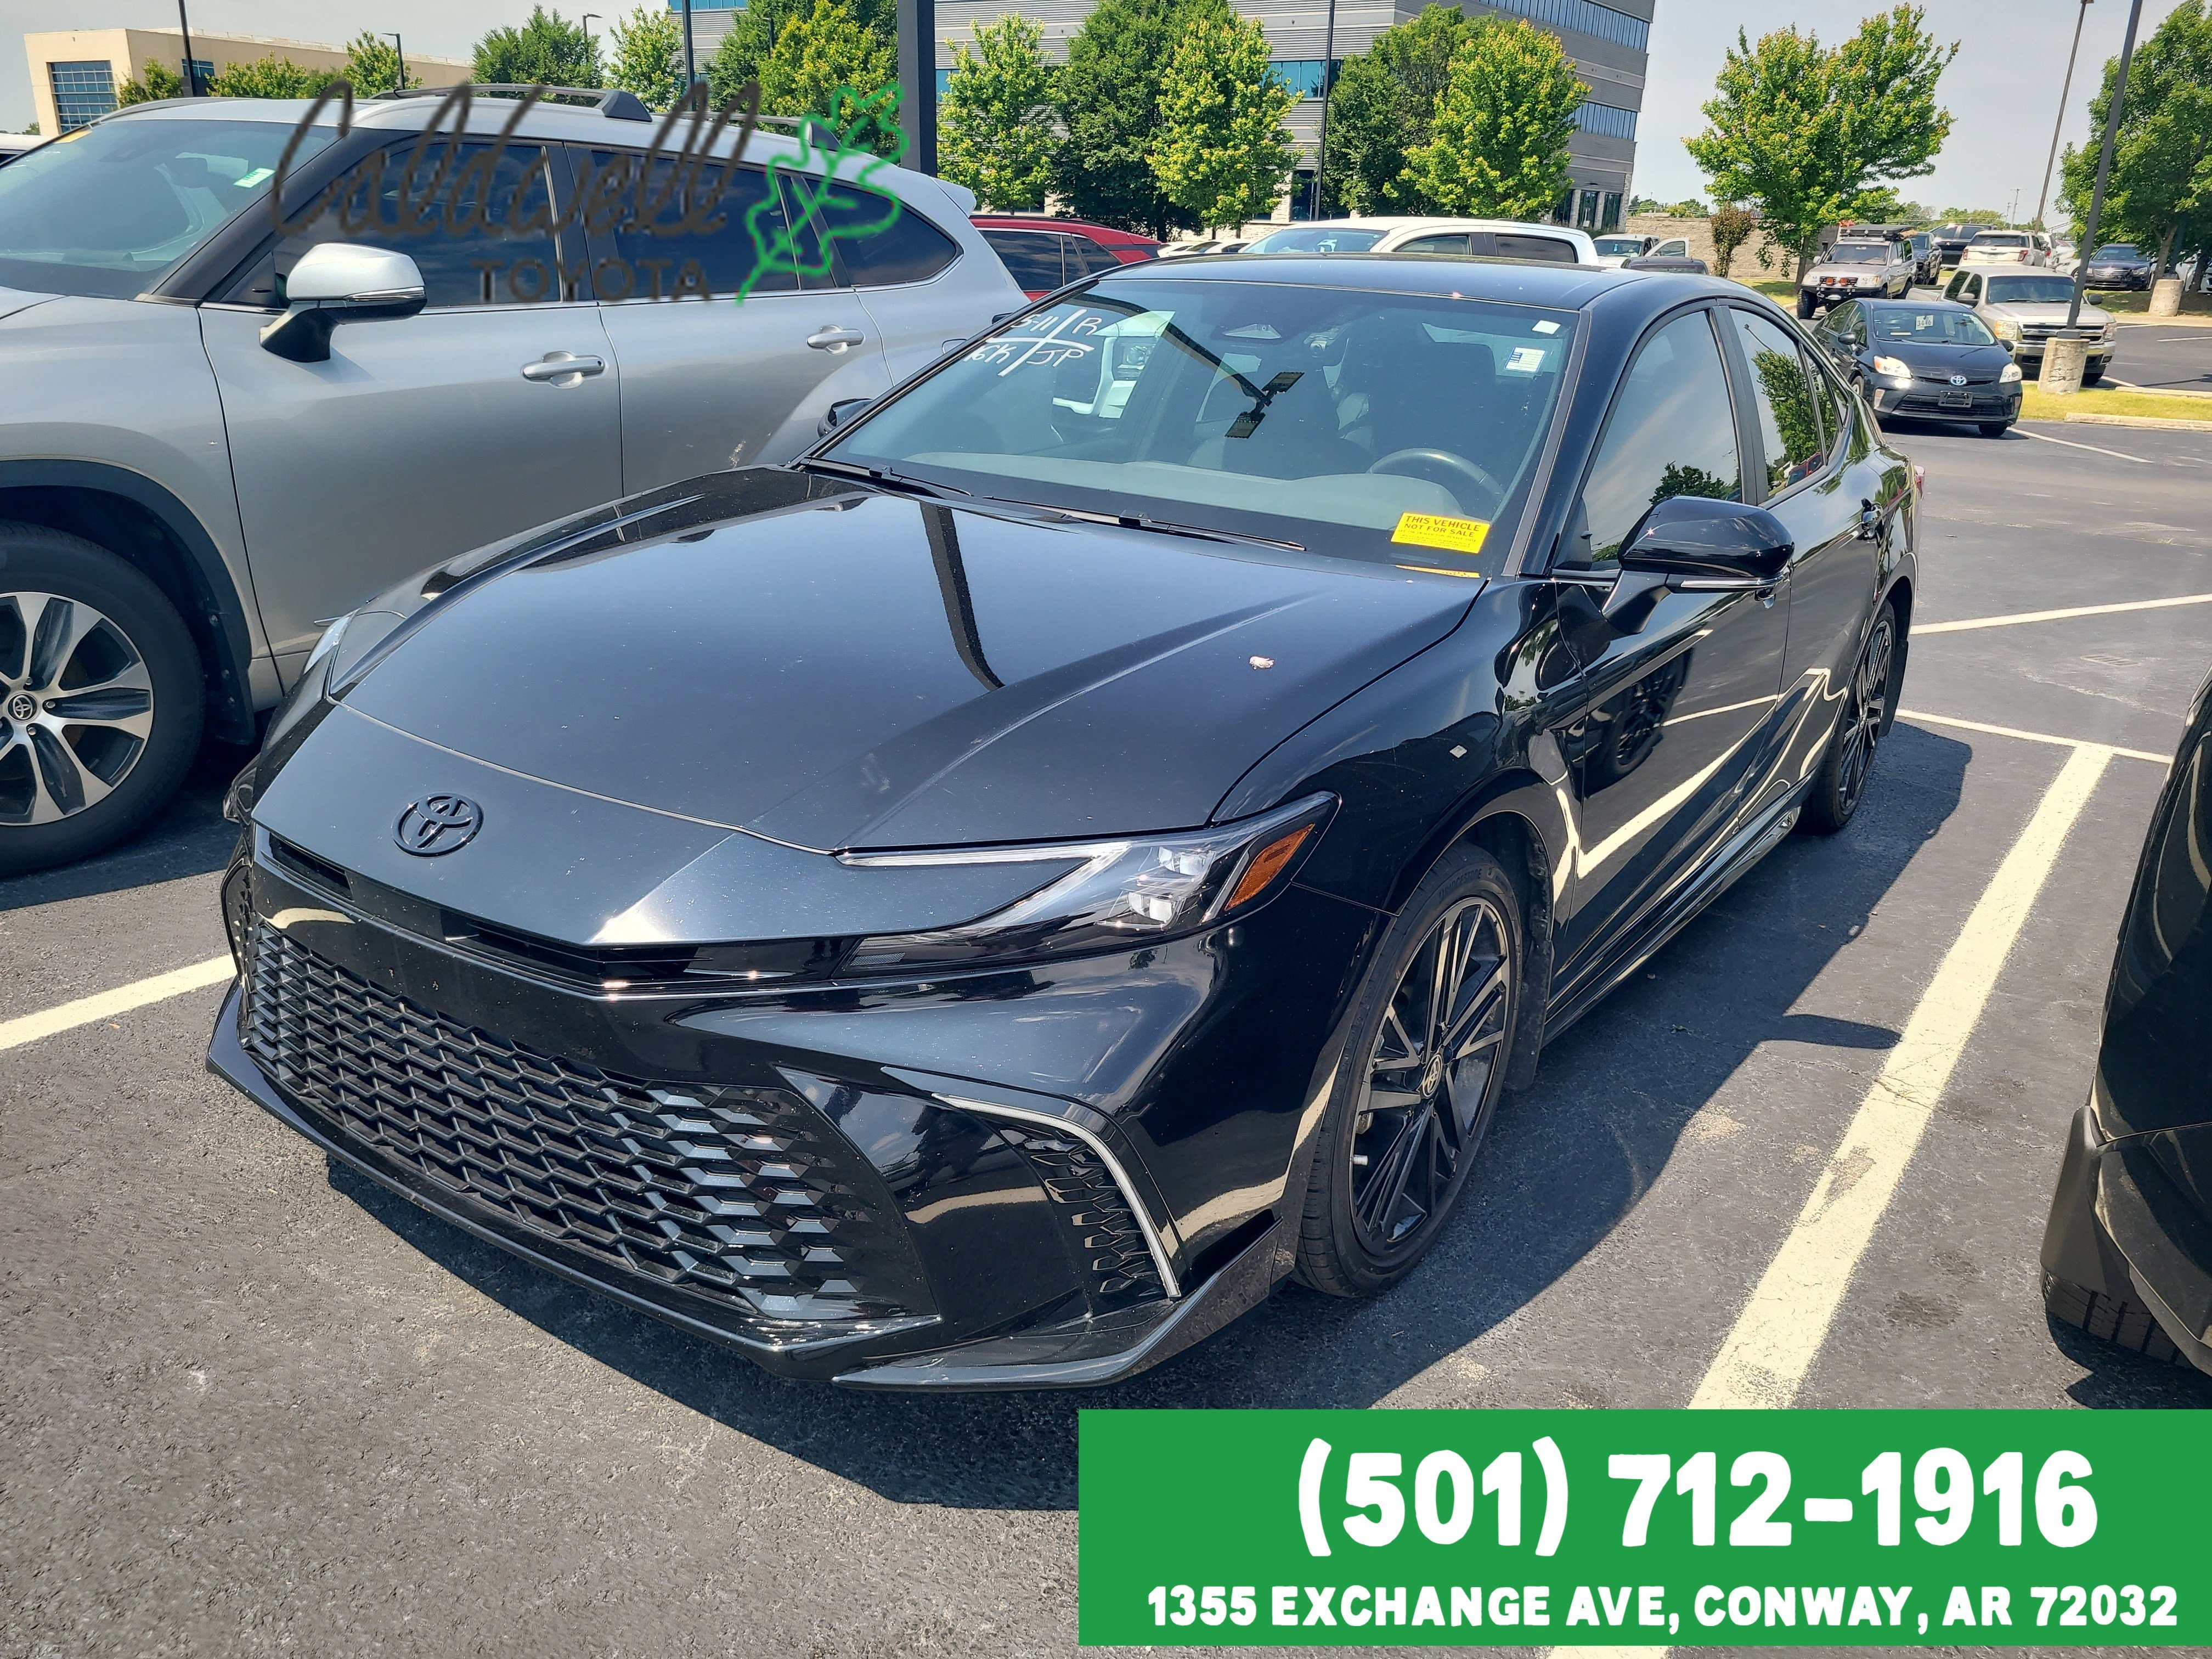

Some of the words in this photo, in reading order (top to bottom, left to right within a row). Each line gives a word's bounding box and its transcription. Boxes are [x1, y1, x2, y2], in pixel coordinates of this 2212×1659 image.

[1072, 317, 1102, 336] R
[1026, 348, 1084, 367] JP
[1406, 516, 1430, 524] THIS
[1435, 519, 1481, 532] VEHICLE
[1449, 529, 1476, 538] SALE
